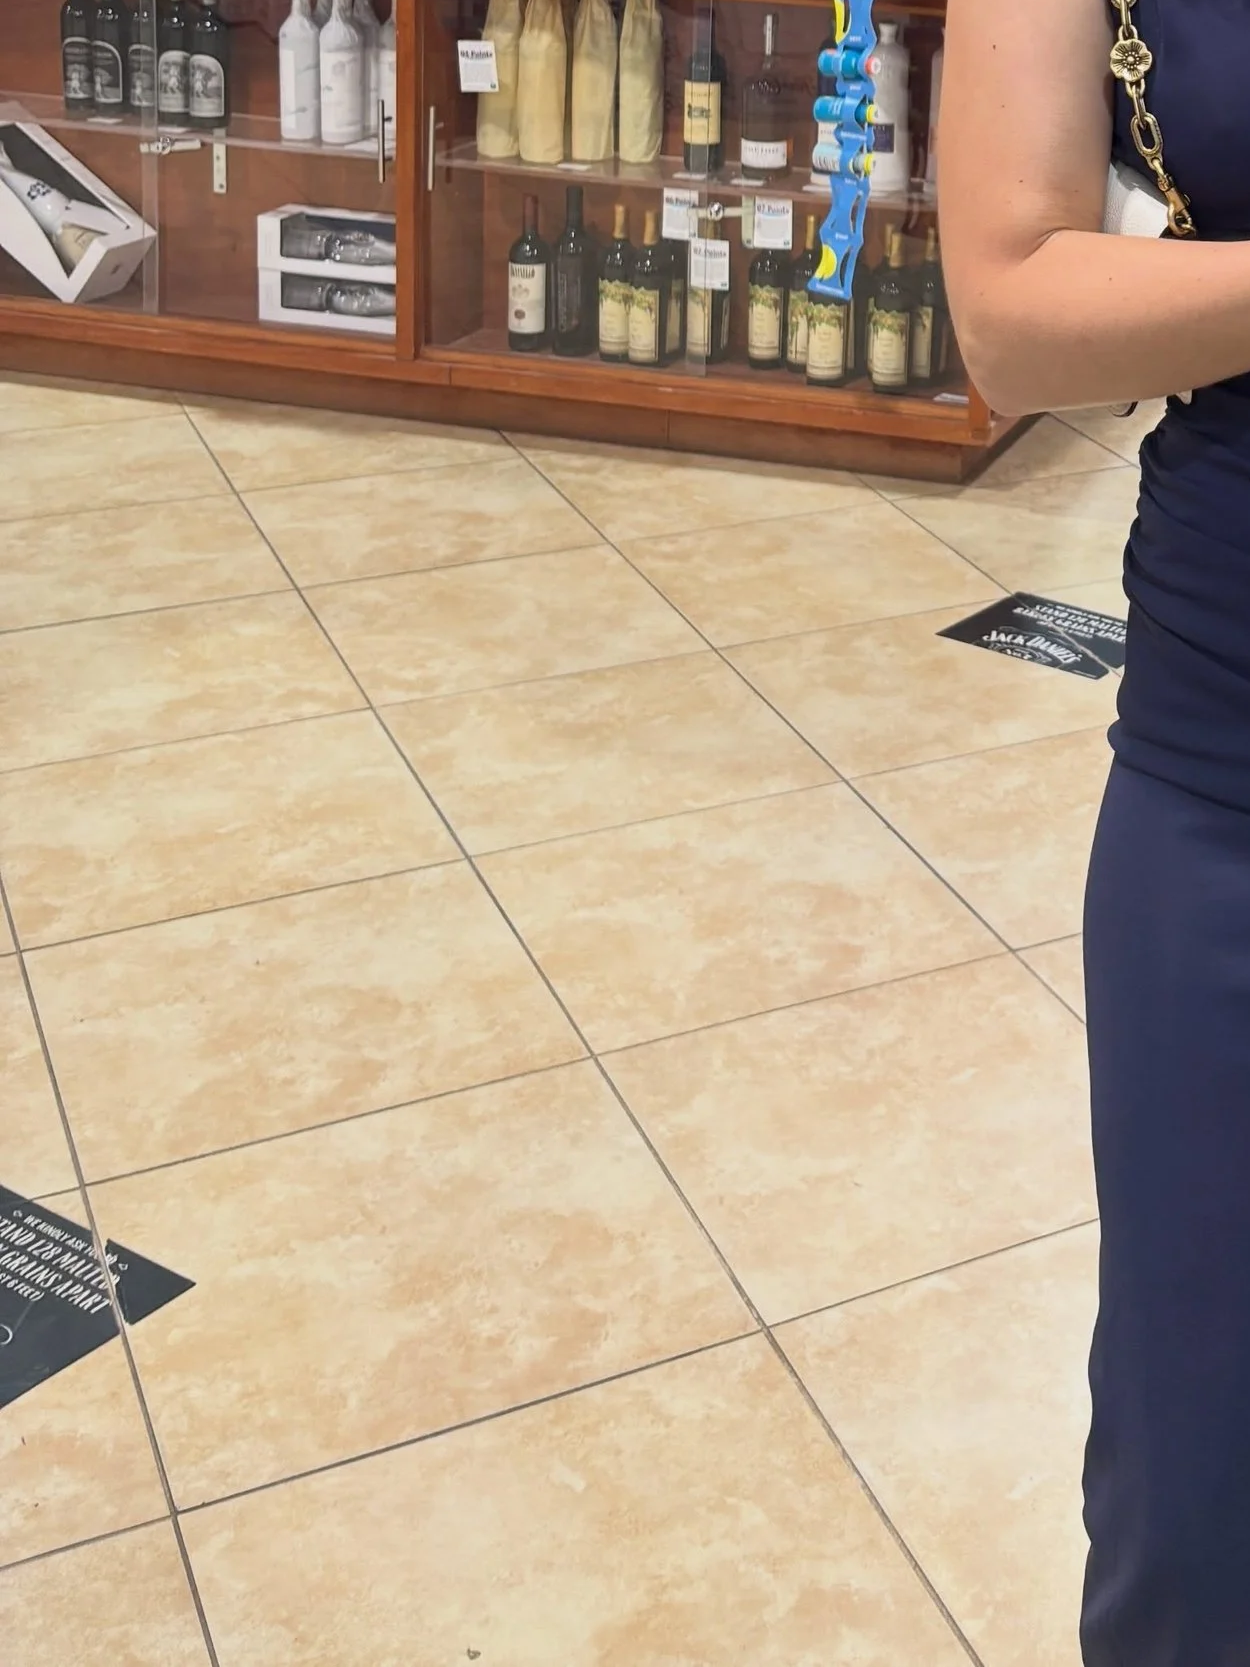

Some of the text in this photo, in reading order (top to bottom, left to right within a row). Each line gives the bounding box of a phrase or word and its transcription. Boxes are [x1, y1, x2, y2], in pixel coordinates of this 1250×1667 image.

[982, 630, 1028, 645] JACK
[27, 1239, 62, 1261] 128
[50, 1280, 113, 1314] APART
